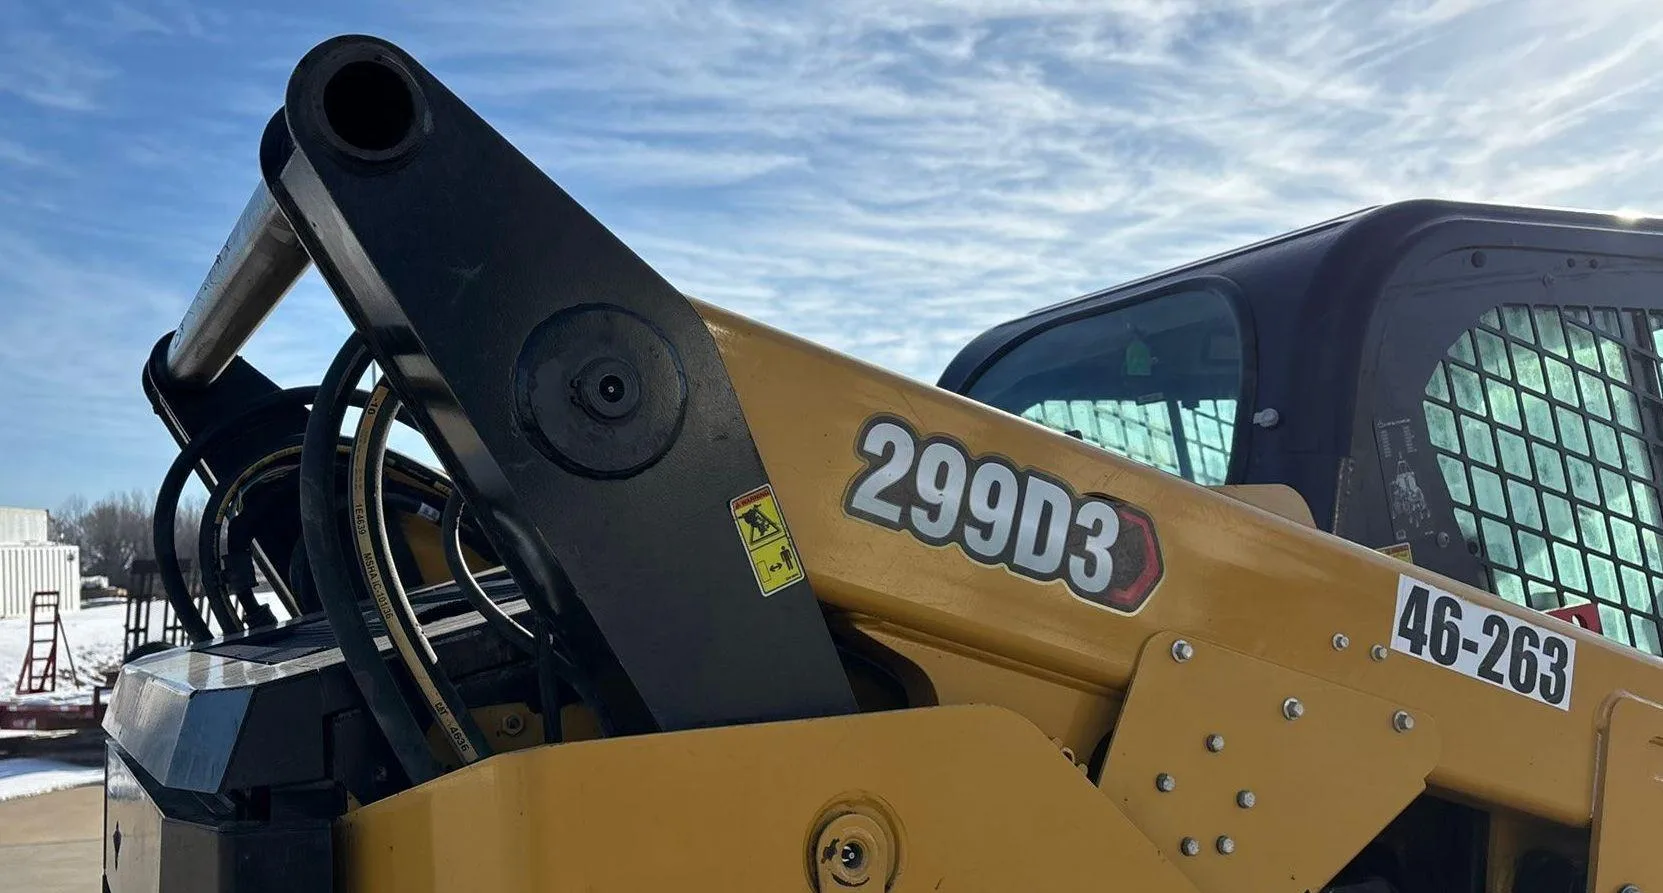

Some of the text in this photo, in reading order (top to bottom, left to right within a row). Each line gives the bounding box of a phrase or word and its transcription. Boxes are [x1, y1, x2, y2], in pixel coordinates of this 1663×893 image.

[851, 422, 1120, 593] 299D3
[362, 552, 378, 579] MSHA
[1397, 585, 1569, 705] 46-263
[434, 701, 448, 715] CAT
